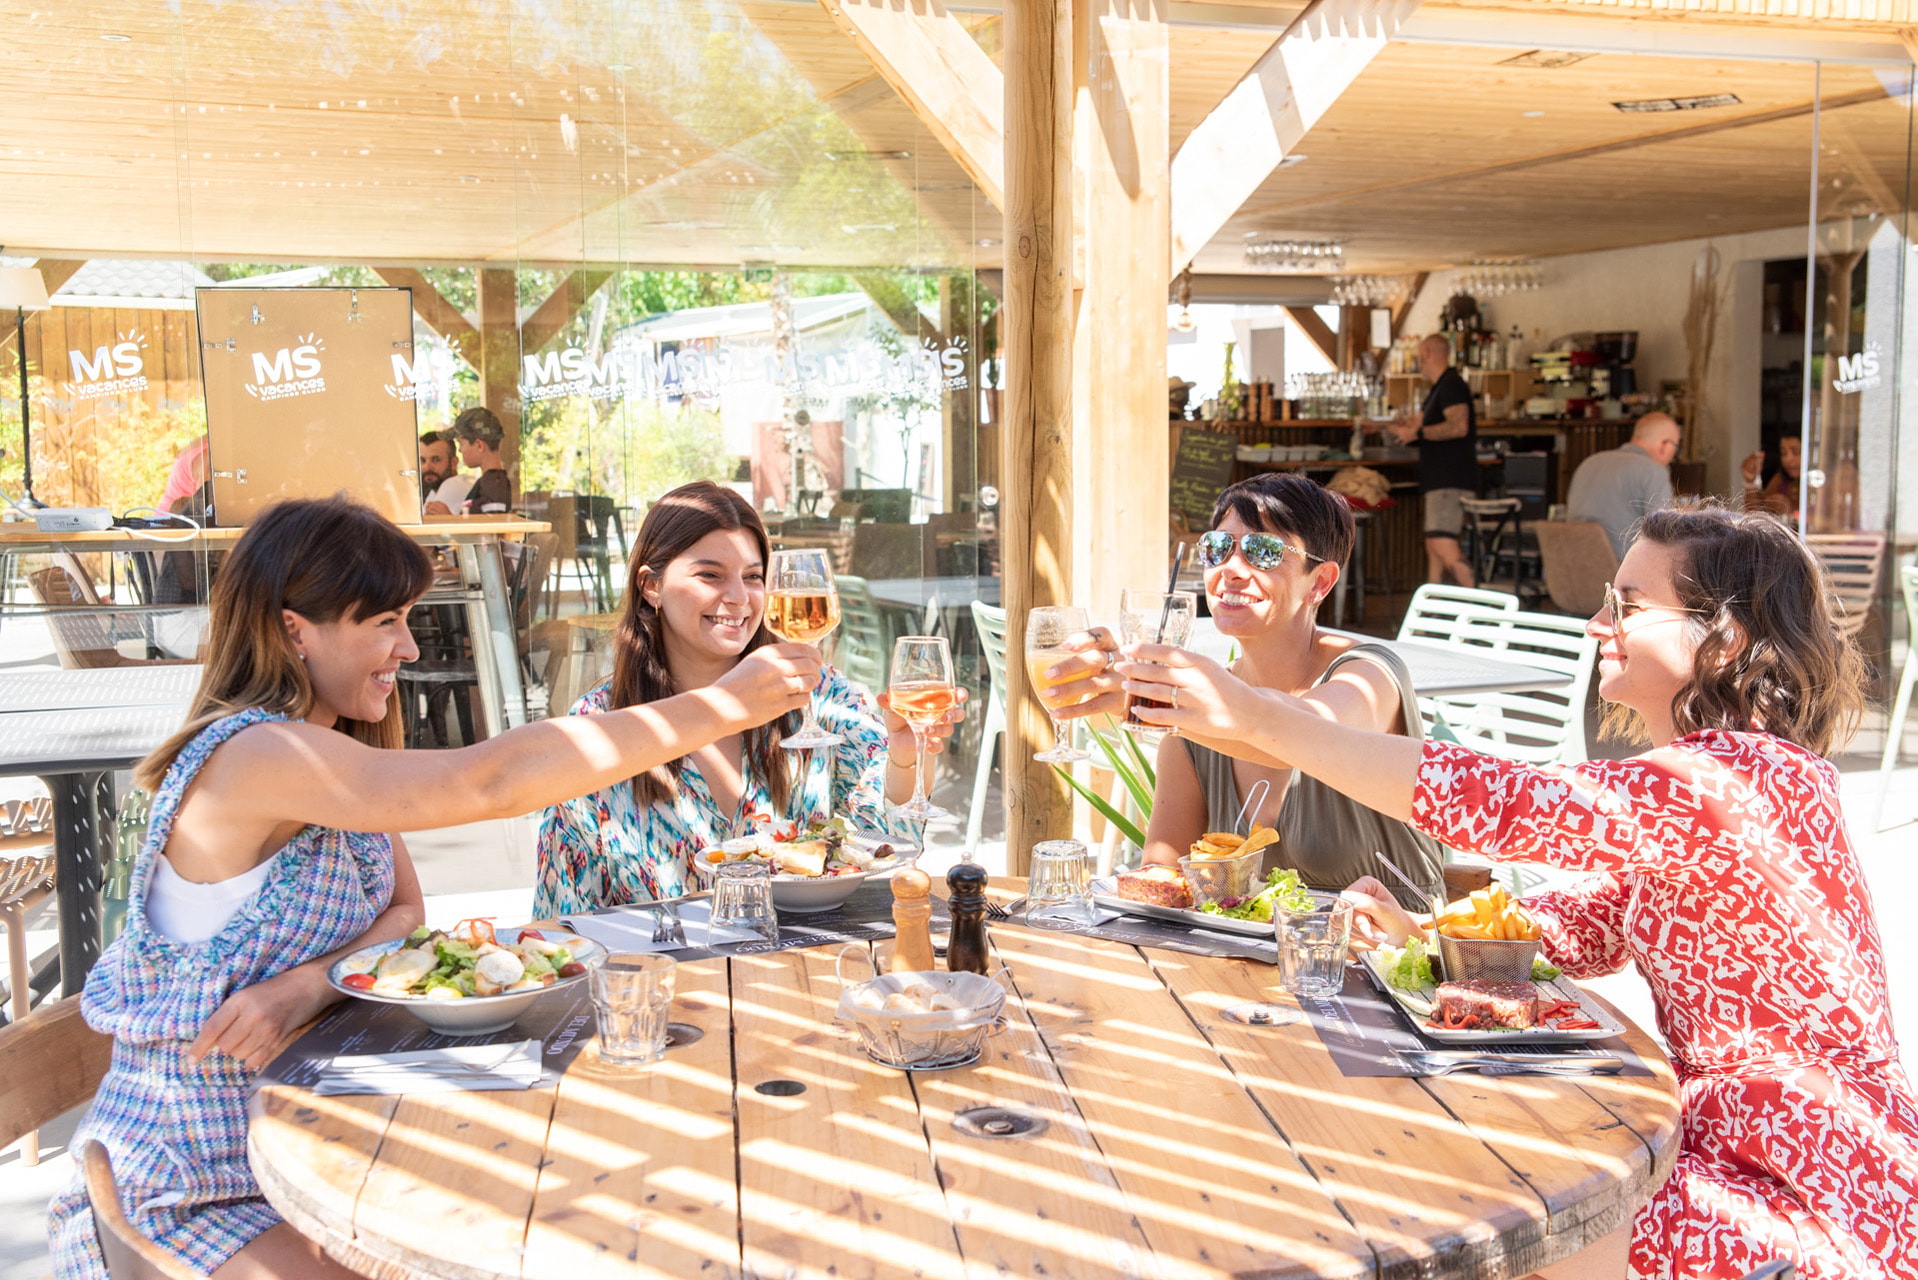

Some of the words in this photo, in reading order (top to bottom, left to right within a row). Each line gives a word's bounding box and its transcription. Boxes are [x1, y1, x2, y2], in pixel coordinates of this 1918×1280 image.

[69, 342, 143, 384] MS
[251, 345, 322, 386] MS
[523, 348, 586, 386] MS
[1837, 350, 1881, 383] MS
[77, 376, 147, 395] vacances
[259, 377, 325, 396] vacances
[567, 1015, 591, 1030] DEL
[1321, 1007, 1340, 1020] DEL
[546, 1027, 581, 1056] MUNDO
